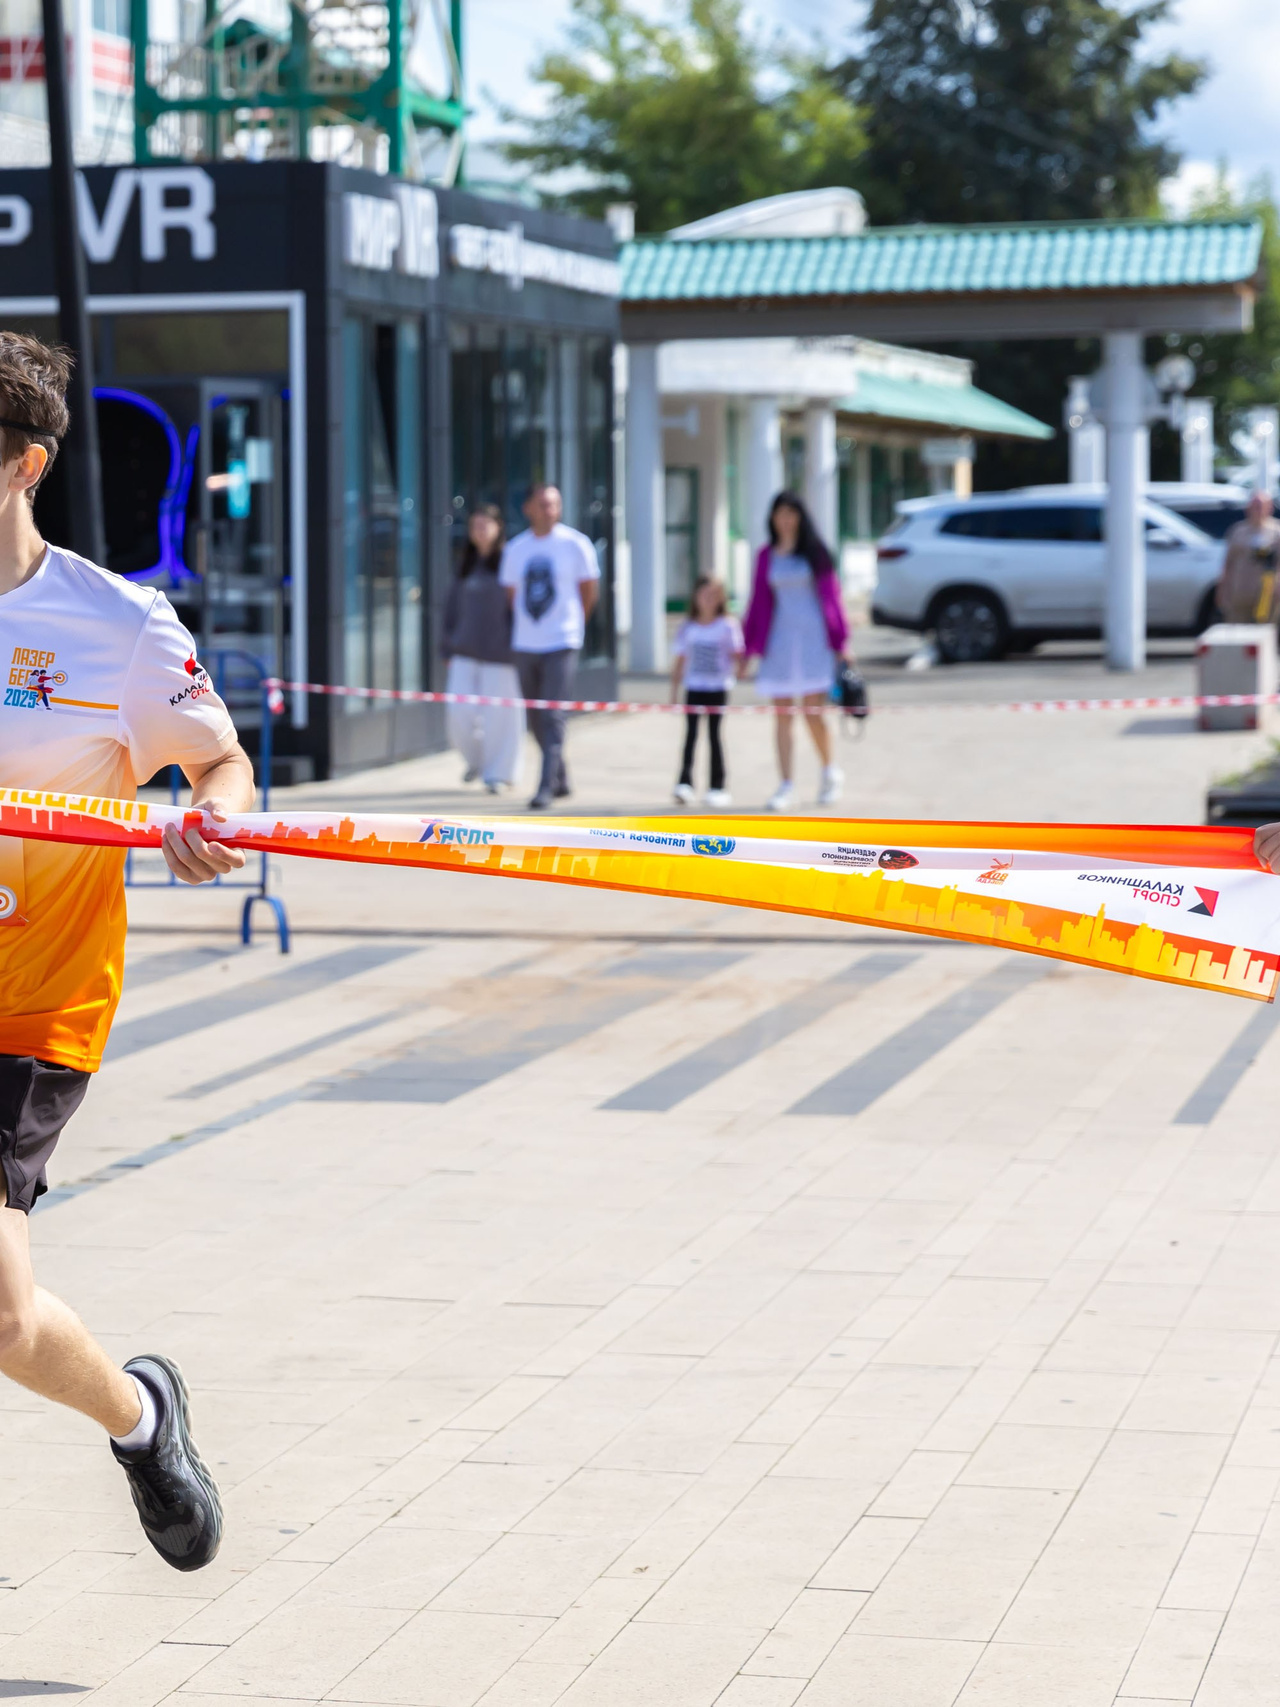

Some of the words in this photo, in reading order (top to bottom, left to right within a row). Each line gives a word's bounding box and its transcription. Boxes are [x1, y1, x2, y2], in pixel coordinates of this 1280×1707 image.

[75, 166, 217, 264] VR
[11, 647, 55, 668] ЛАЗЕР
[8, 667, 33, 686] БЕГ
[3, 688, 38, 709] 2025
